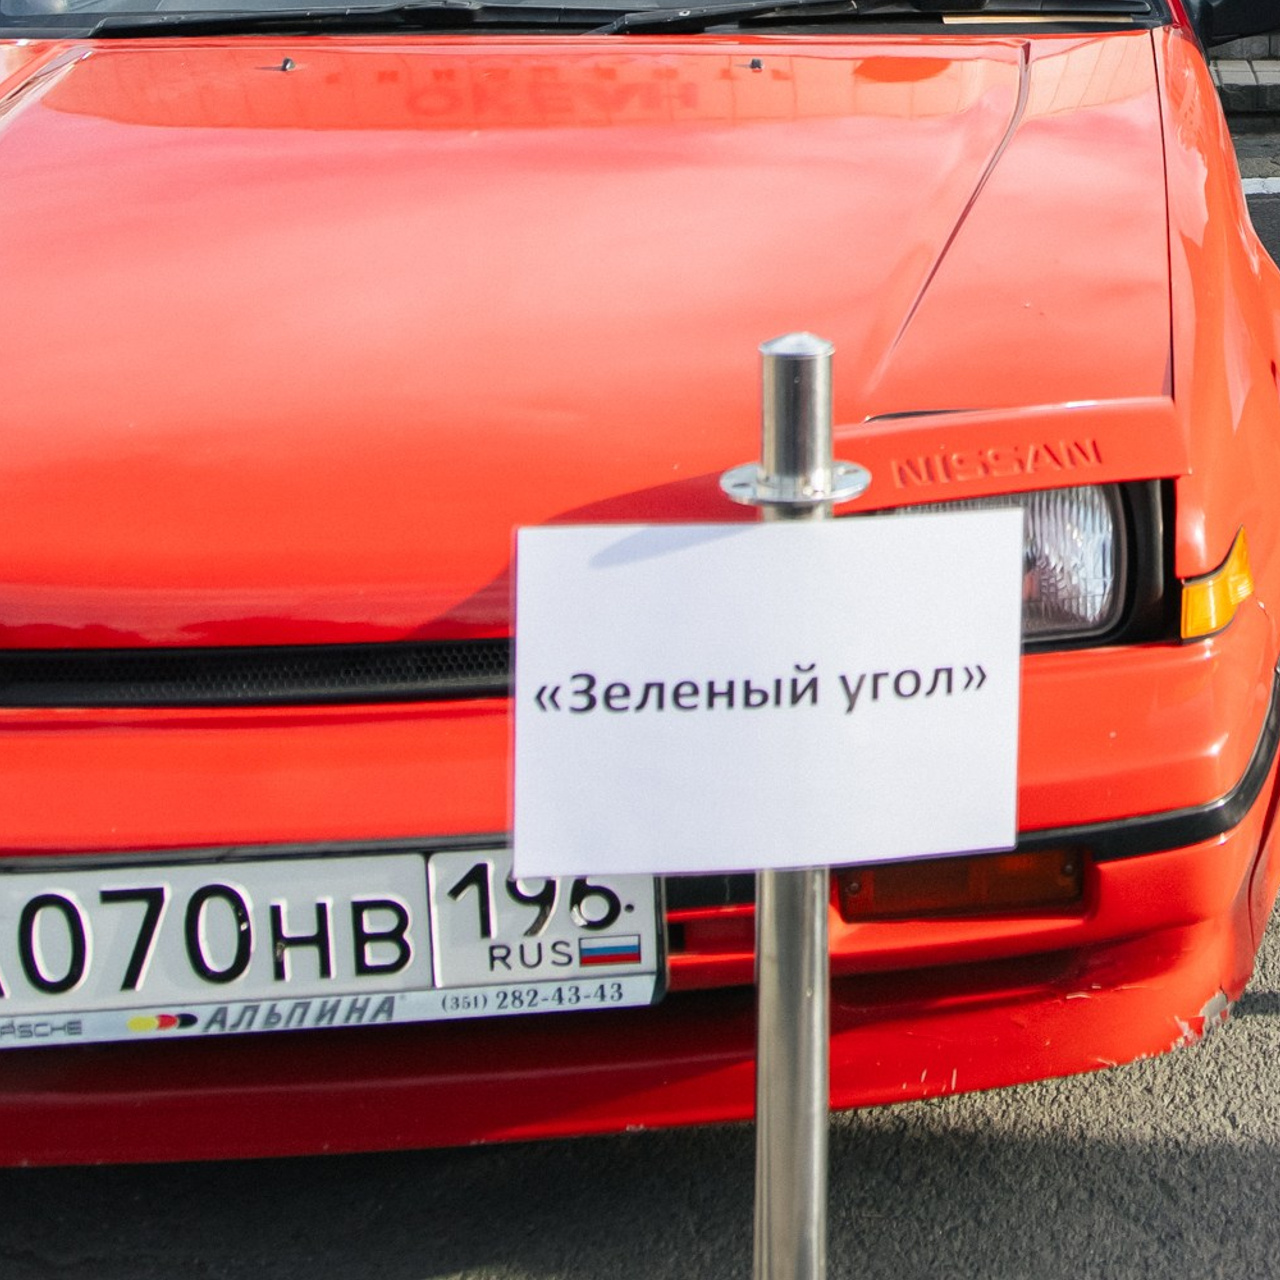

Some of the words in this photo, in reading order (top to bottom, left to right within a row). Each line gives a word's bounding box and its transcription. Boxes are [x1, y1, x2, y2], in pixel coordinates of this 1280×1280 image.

[891, 439, 1102, 488] NISSAN
[534, 665, 819, 715] «Зеленый
[839, 662, 988, 716] угол»
[0, 883, 412, 998] 070НВ
[488, 940, 573, 971] RUS
[202, 995, 395, 1033] АЛЬПИНА
[441, 993, 488, 1011] (351)
[495, 982, 624, 1010] 282-43-43
